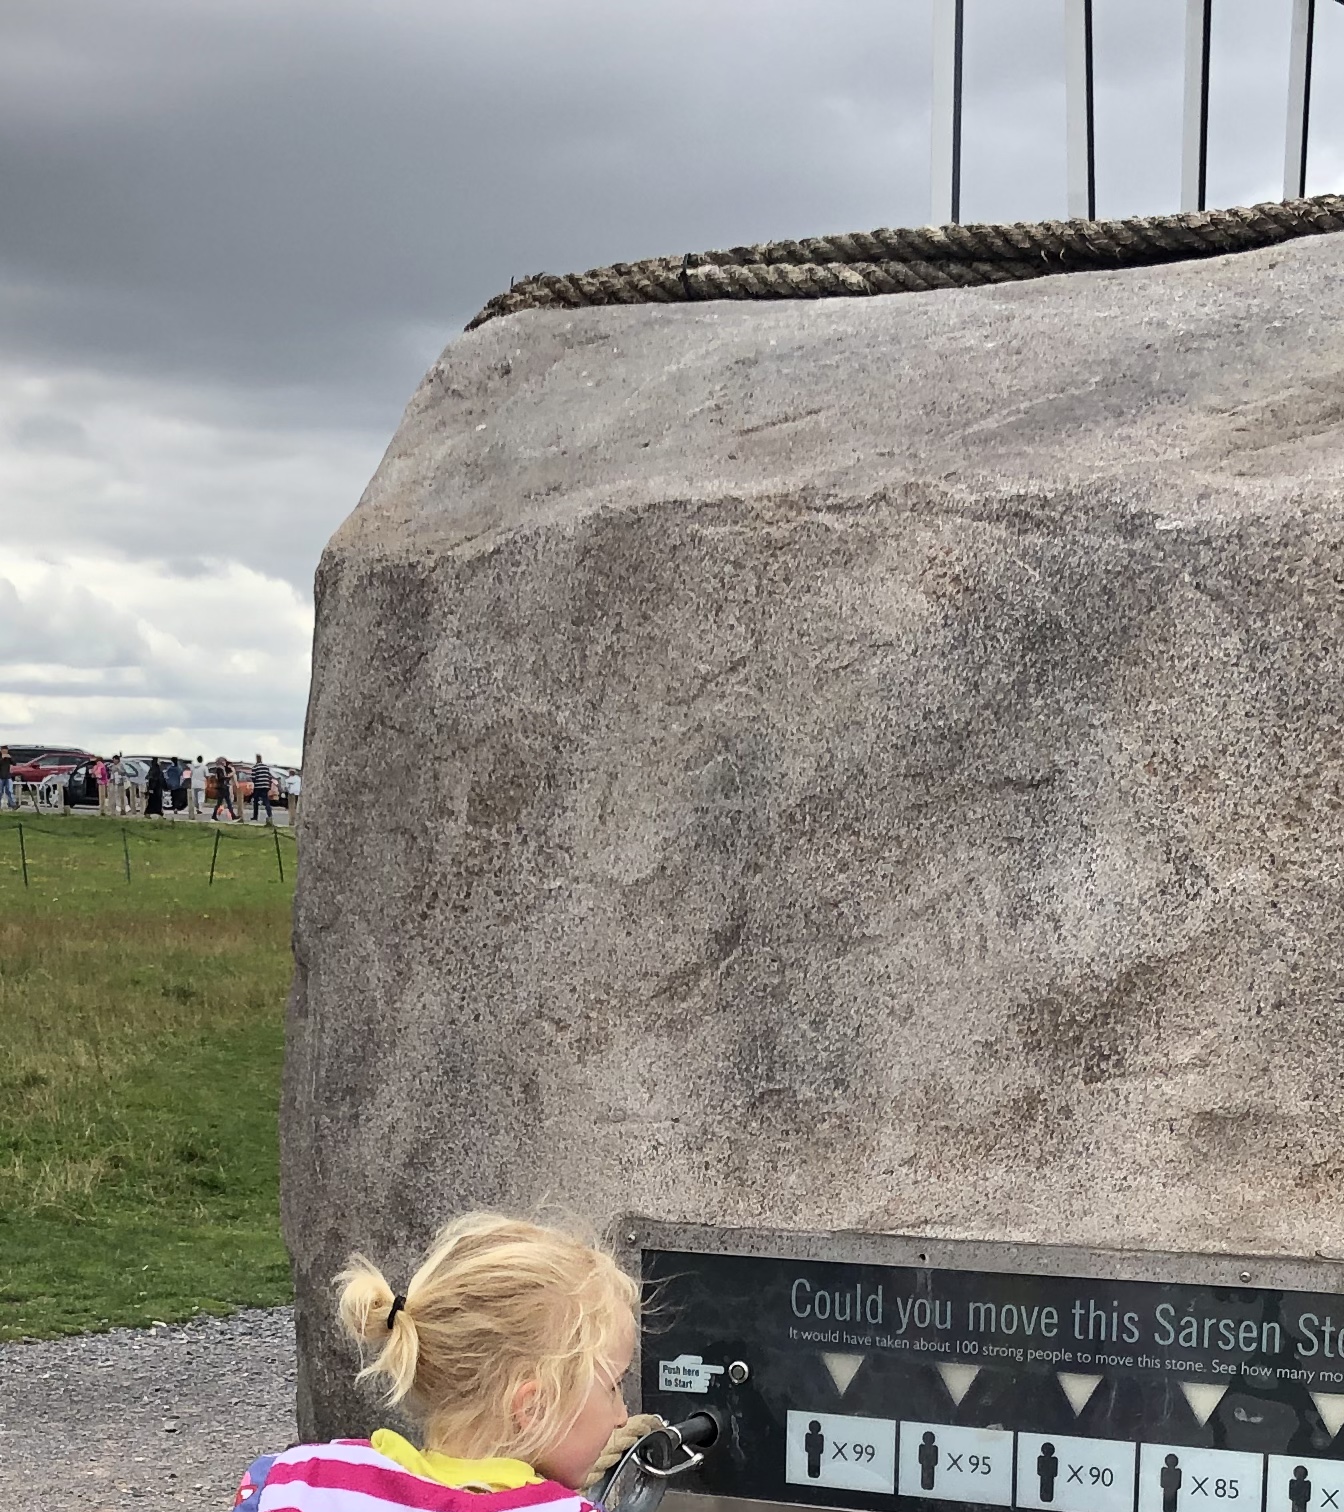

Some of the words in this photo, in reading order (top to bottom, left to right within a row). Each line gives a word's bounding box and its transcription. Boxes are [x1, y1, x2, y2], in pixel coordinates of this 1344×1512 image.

[791, 1278, 883, 1324] Could
[895, 1294, 952, 1334] you
[968, 1301, 1058, 1337] move
[1072, 1300, 1139, 1344] this
[1154, 1303, 1281, 1353] Sarsen
[663, 1364, 680, 1375] Push
[683, 1366, 699, 1377] here
[789, 1327, 798, 1339] It
[801, 1329, 839, 1343] would
[843, 1333, 872, 1347] have
[875, 1335, 909, 1350] taken
[913, 1338, 950, 1353] about
[956, 1341, 979, 1355] 100
[982, 1344, 1023, 1362] strong
[1027, 1348, 1072, 1364] people
[1077, 1351, 1092, 1364] to
[1095, 1354, 1134, 1368] move
[1137, 1355, 1161, 1370] this
[1165, 1359, 1206, 1373] stone.
[1211, 1360, 1237, 1376] See
[1241, 1363, 1272, 1378] how
[1276, 1366, 1315, 1383] many
[664, 1378, 672, 1387] to
[674, 1378, 692, 1389] Start
